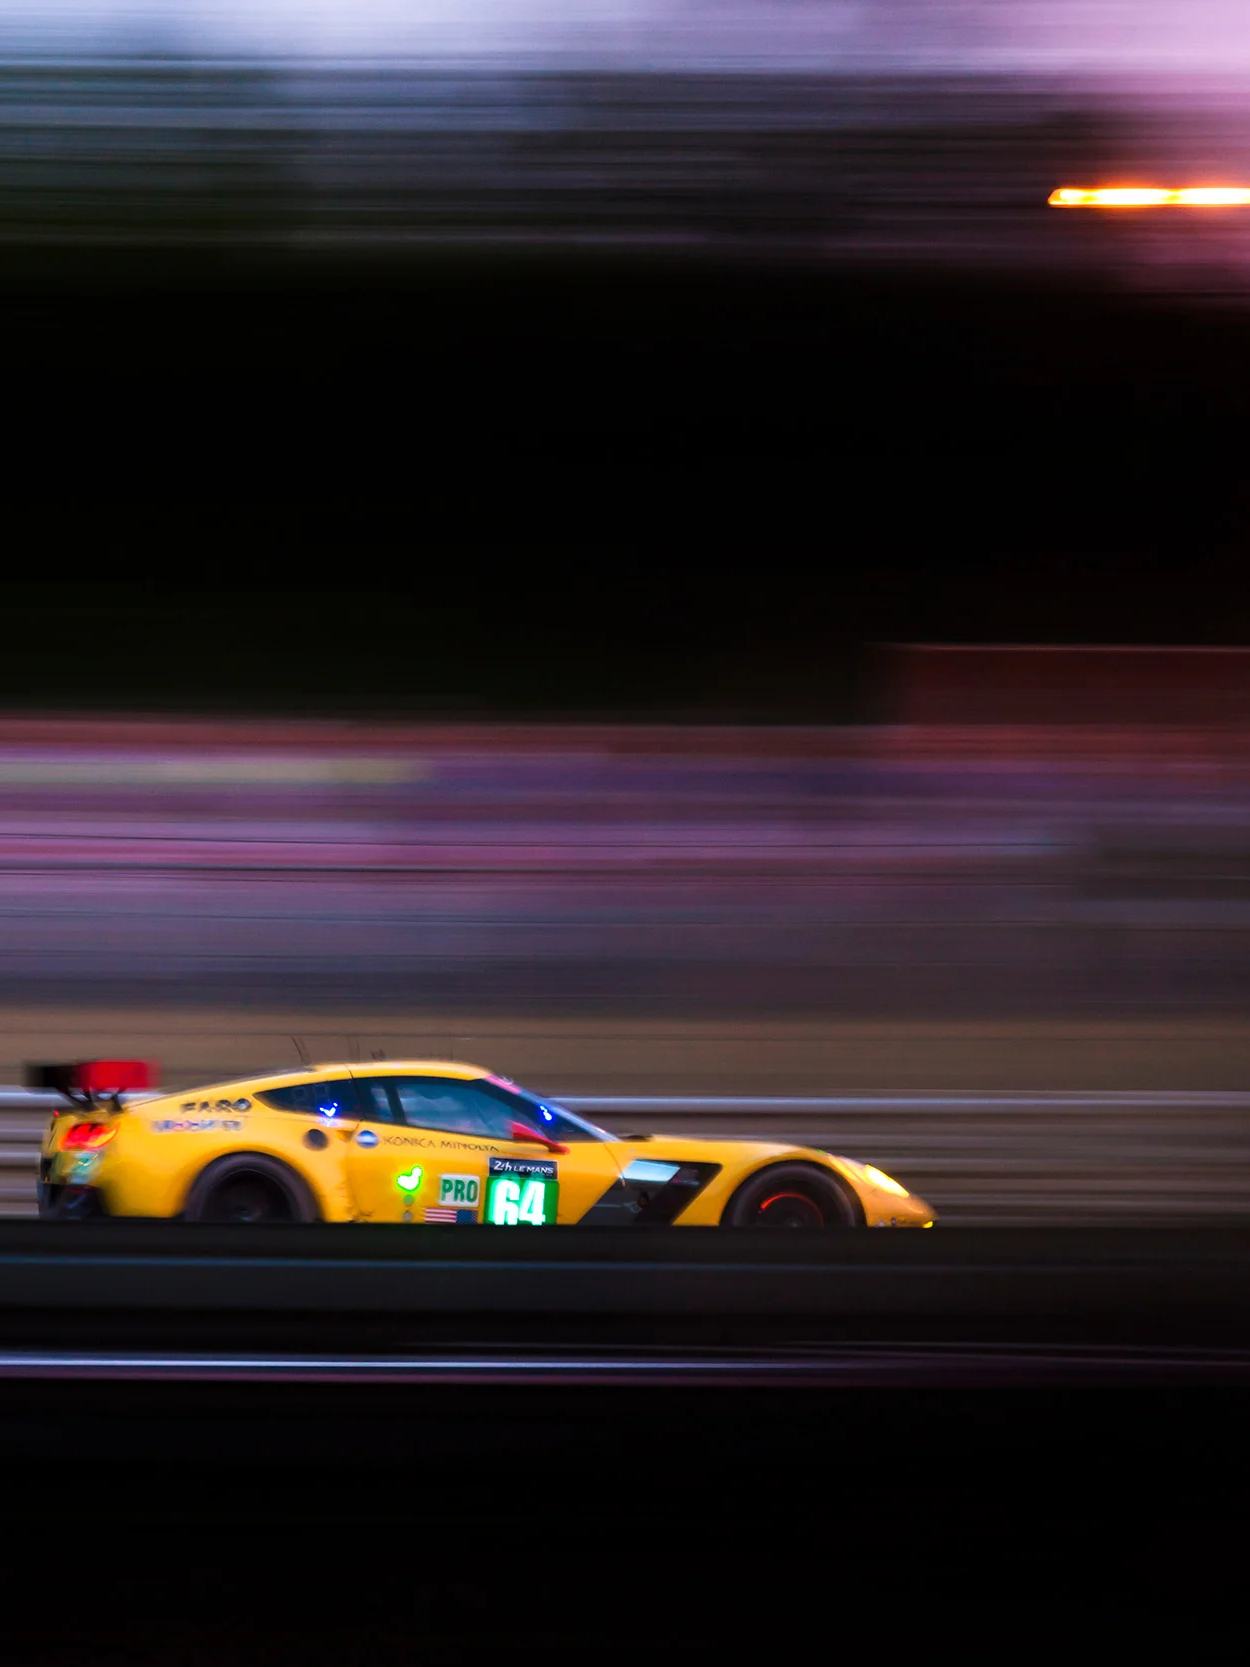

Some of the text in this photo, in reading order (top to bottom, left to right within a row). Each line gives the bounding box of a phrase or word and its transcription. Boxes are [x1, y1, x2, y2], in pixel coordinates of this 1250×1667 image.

[382, 1135, 500, 1153] KONICA MINOLTA
[513, 1165, 526, 1173] LE
[526, 1166, 555, 1175] MANS
[441, 1178, 478, 1203] PRO
[493, 1179, 546, 1226] 64
